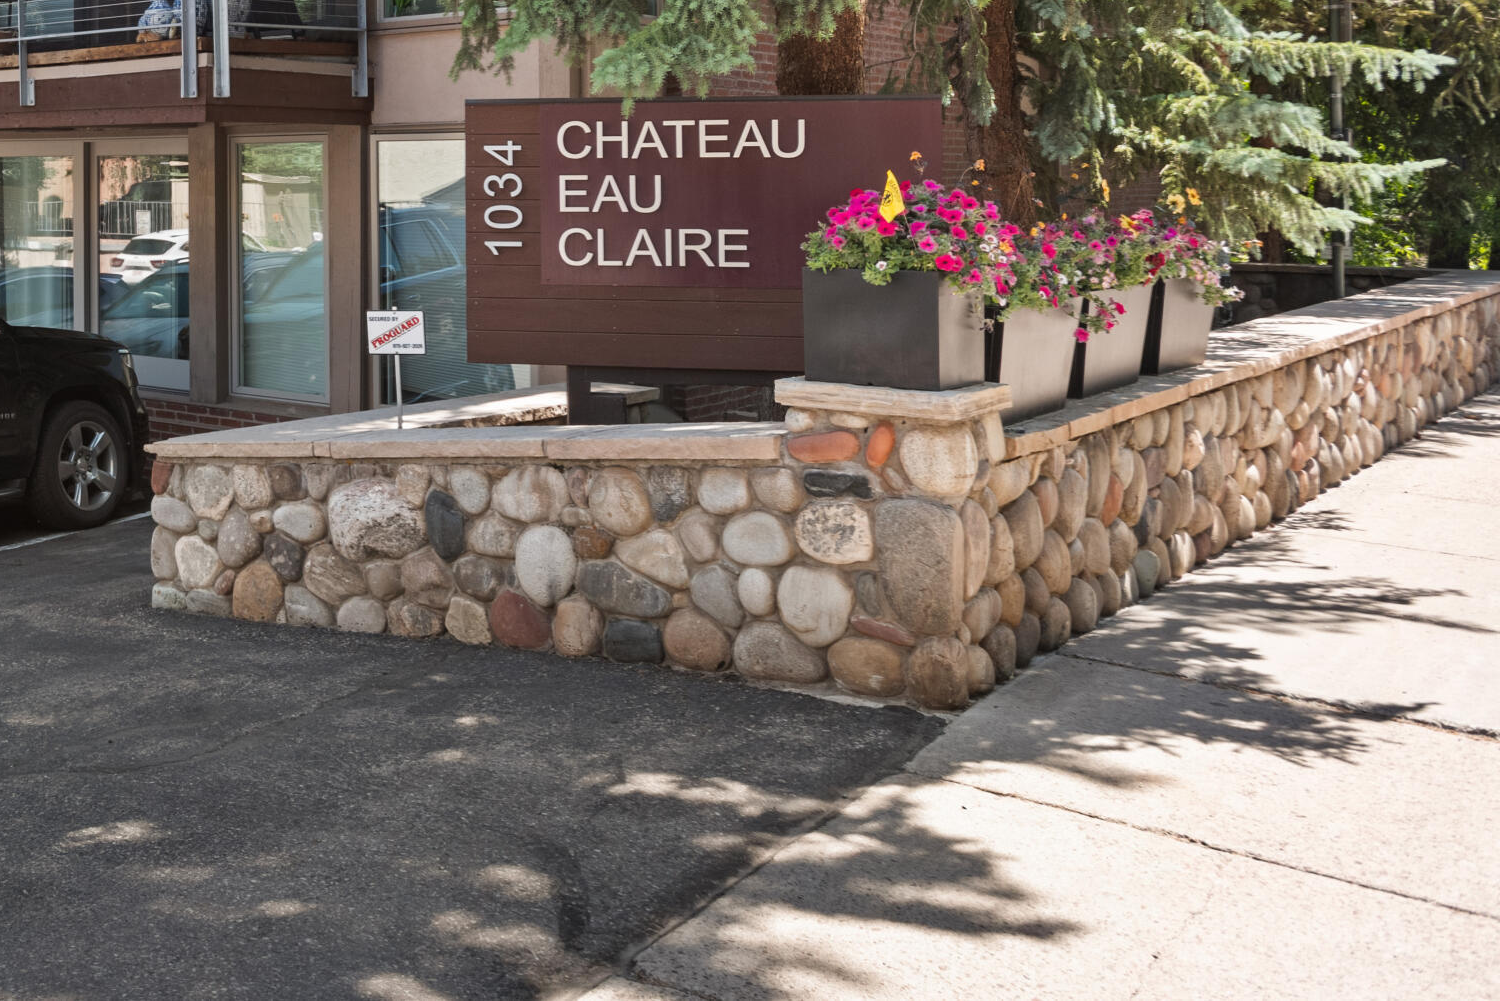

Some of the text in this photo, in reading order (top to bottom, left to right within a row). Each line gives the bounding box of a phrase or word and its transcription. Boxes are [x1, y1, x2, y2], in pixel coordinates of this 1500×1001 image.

[556, 118, 806, 160] CHATEAU
[483, 140, 523, 256] 1034
[558, 174, 662, 214] EAU
[558, 227, 750, 268] CLAIRE
[371, 316, 420, 348] PROGUARD
